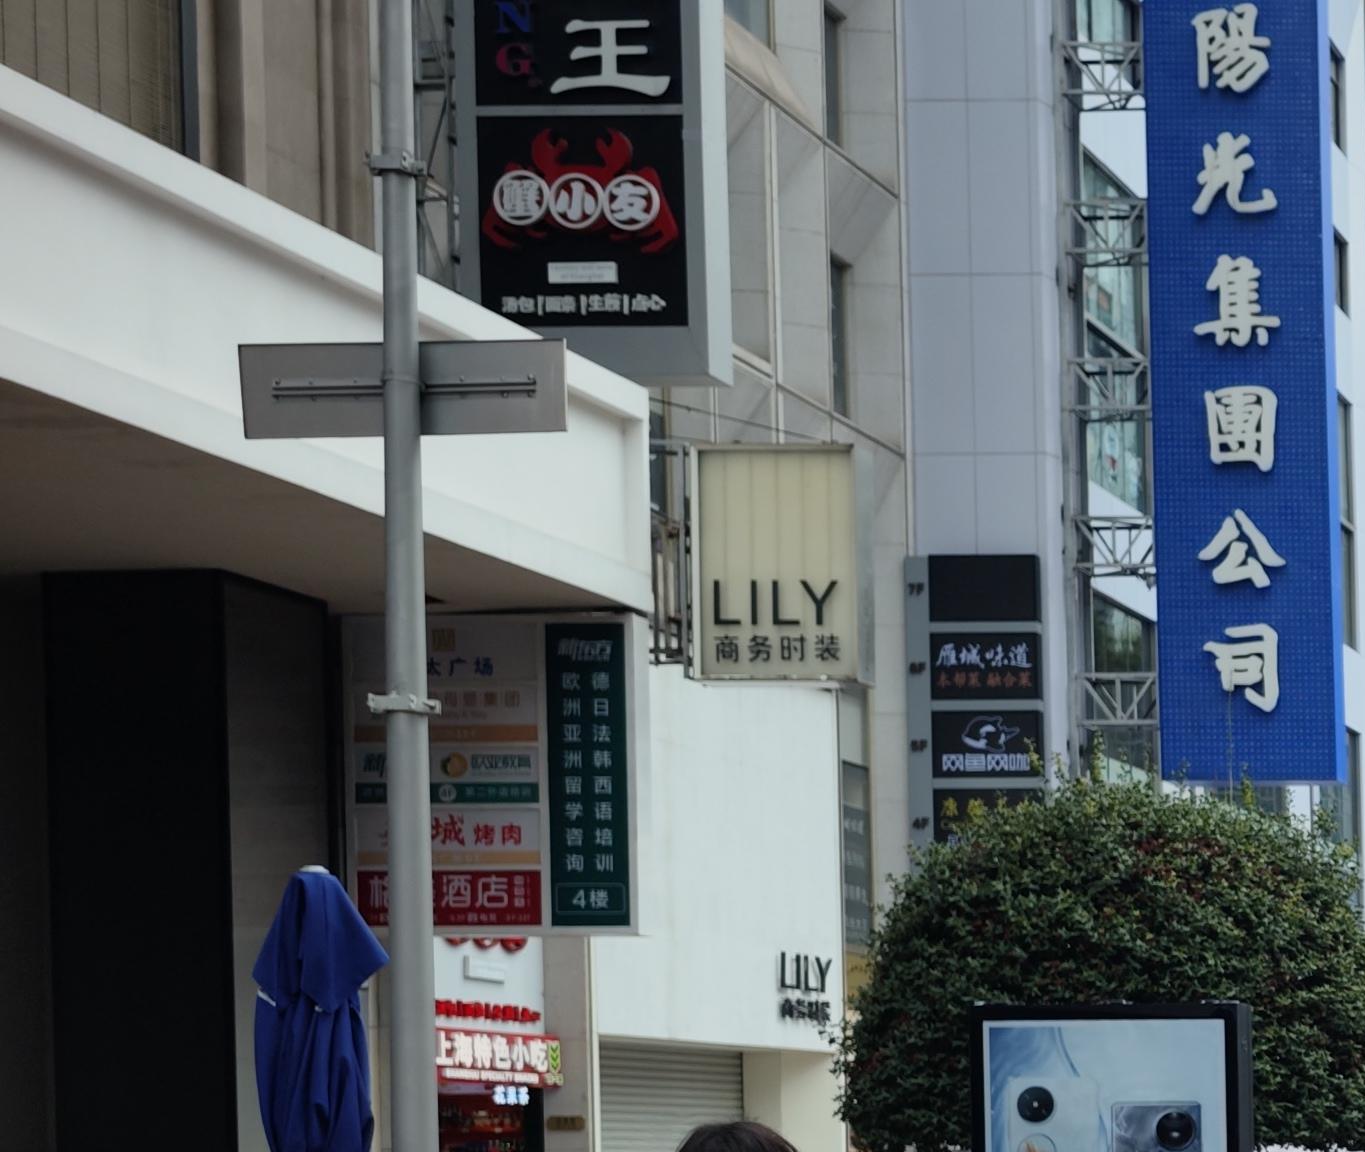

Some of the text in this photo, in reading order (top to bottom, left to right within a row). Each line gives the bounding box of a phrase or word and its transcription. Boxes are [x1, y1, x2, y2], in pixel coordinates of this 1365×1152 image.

[1192, 3, 1286, 712] 陽光集團公司
[713, 580, 838, 625] LILY
[714, 634, 841, 663] 商务时装
[781, 952, 832, 992] LILY
